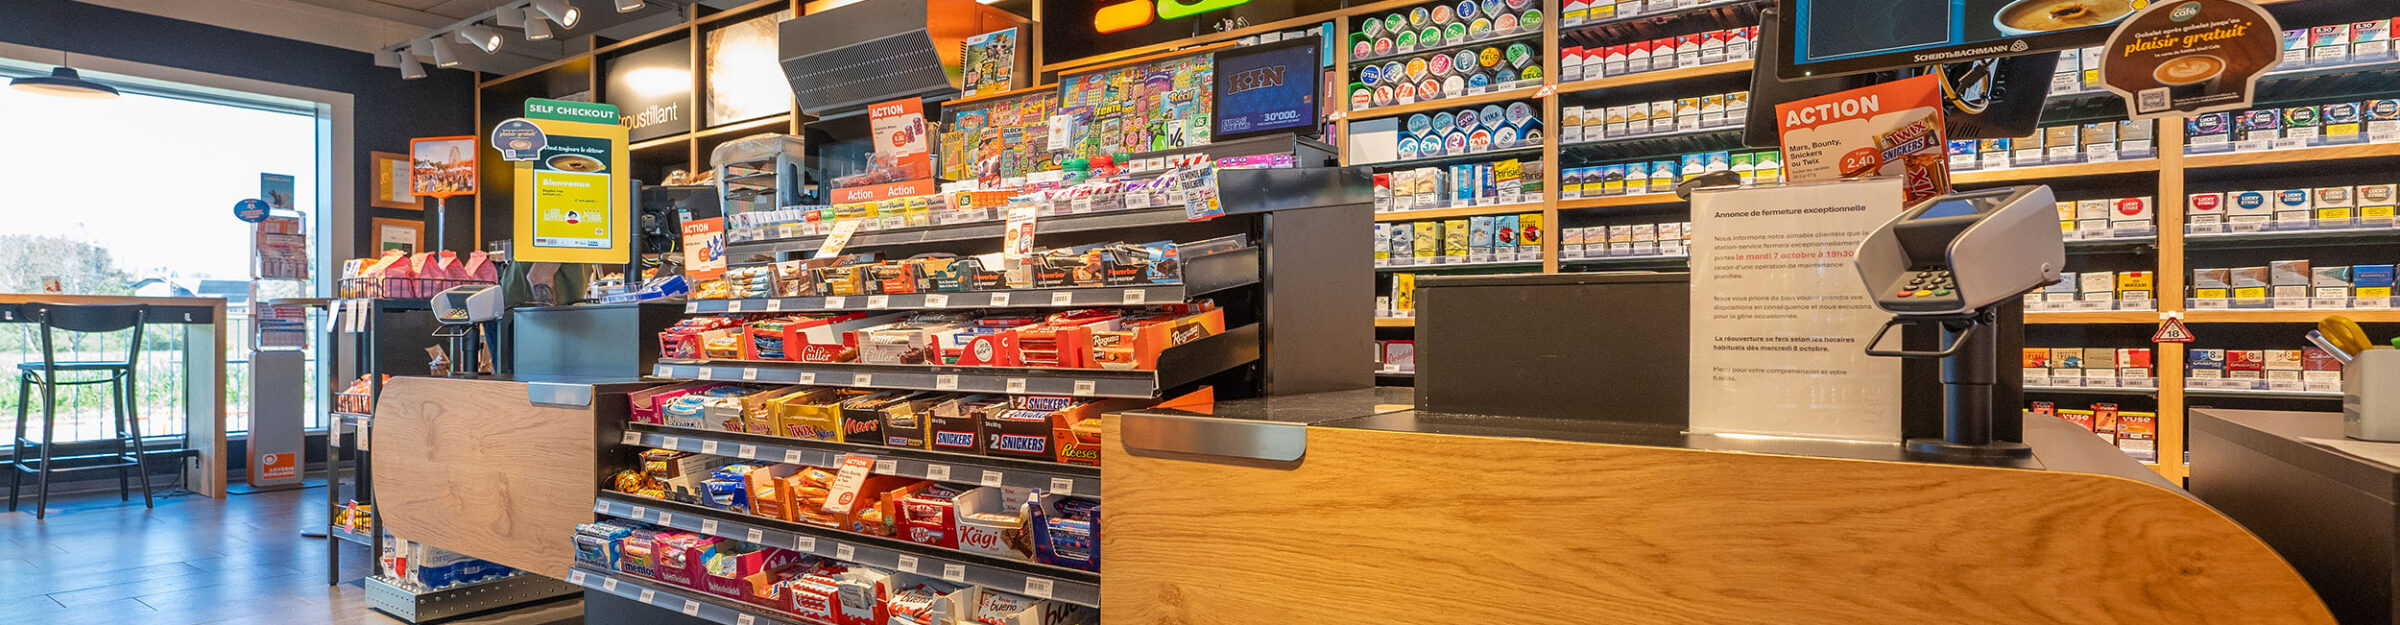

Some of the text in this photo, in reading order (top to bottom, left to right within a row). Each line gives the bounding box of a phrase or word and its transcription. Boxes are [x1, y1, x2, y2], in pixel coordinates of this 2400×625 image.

[2173, 7, 2197, 18] café
[2134, 17, 2241, 39] Gobelet après gobelet jusqu'au
[1422, 31, 1438, 43] VELO
[2124, 37, 2179, 57] plaisir
[1228, 65, 1286, 95] KIN
[1168, 88, 1196, 106] Récif
[529, 103, 615, 119] SELF CHECKOUT
[618, 101, 678, 131] roustillant
[872, 104, 904, 118] ACTION
[1484, 112, 1498, 122] VIKA
[1785, 94, 1880, 128] ACTION
[1459, 115, 1474, 125] ZYN
[1170, 127, 1185, 149] V6
[1886, 121, 1927, 146] TWIX
[558, 145, 580, 153] toujours
[1789, 139, 1842, 153] Mars, Bounty,
[1882, 137, 1925, 161] SNICKERS
[1790, 150, 1823, 160] Snickers
[1847, 155, 1875, 169] 2.40
[1802, 158, 1820, 167] Twix
[543, 178, 591, 188] Bienvenue
[848, 185, 915, 201] Action Action
[1714, 205, 1866, 219] Annonce de fermeture exceptionnelle
[684, 223, 709, 234] ACTION
[1814, 230, 1846, 239] clientèle
[1714, 242, 1762, 251] station-service
[1790, 240, 1860, 249] exceptionnellement
[1736, 252, 1744, 260] le
[1746, 251, 1772, 260] mardi
[1774, 252, 1779, 260] 7
[1780, 250, 1816, 260] octobre
[1817, 249, 1824, 258] à
[1826, 249, 1855, 258] 19h30
[1754, 262, 1787, 271] opération
[1714, 273, 1743, 281] planifiée.
[1748, 295, 1769, 303] prions
[1821, 295, 1849, 303] prendre
[1713, 304, 1753, 312] dispositions
[1764, 304, 1810, 312] conséquence
[1736, 312, 1753, 320] gêne
[1093, 334, 1120, 347] Ragusa
[1172, 325, 1198, 345] Ragusa
[2166, 330, 2180, 338] 18
[801, 345, 832, 362] Cailler
[865, 348, 898, 363] Cailler
[1018, 397, 1069, 411] 2 SNICKERS
[787, 424, 815, 437] TWIX
[844, 418, 879, 434] Mars
[937, 431, 973, 446] SNICKERS
[990, 433, 1045, 452] 2 SNICKERS
[1061, 443, 1097, 459] Reese's
[846, 459, 868, 467] ACTION
[959, 526, 1000, 549] Kägi
[625, 563, 655, 577] mentos
[900, 592, 930, 604] bueno
[990, 602, 1017, 612] bueno
